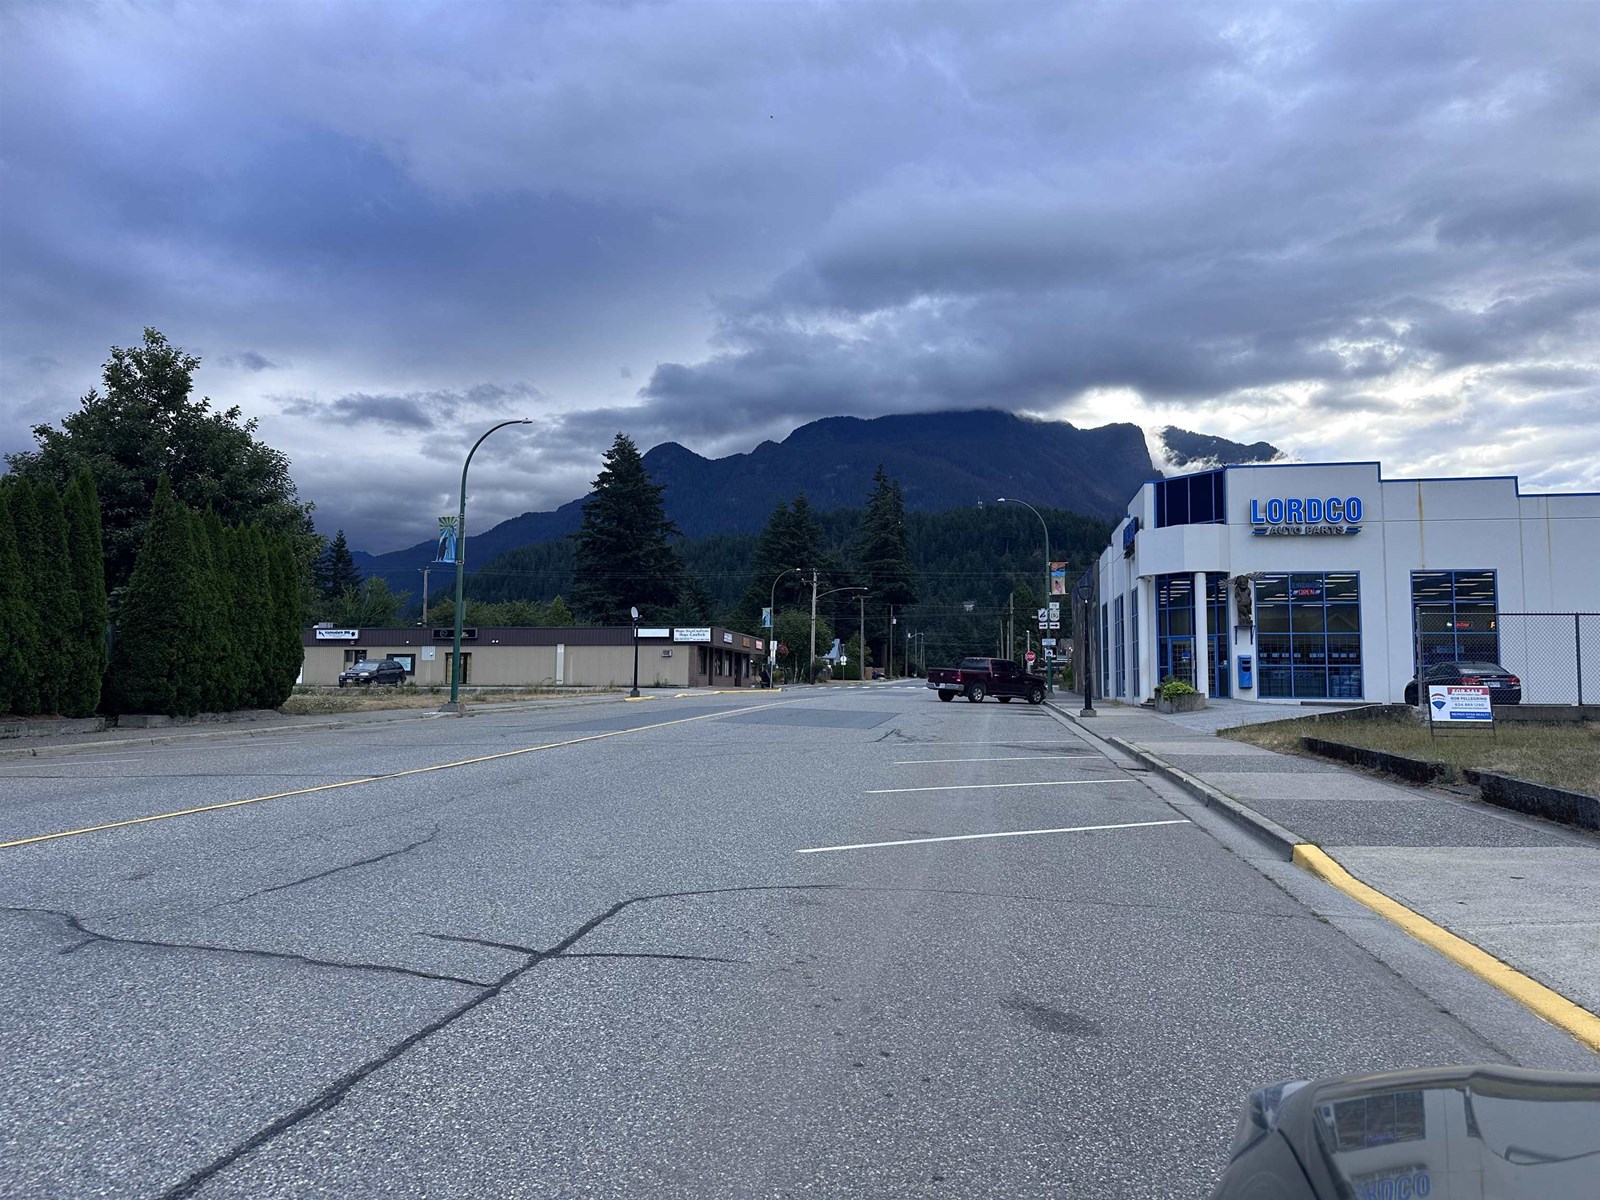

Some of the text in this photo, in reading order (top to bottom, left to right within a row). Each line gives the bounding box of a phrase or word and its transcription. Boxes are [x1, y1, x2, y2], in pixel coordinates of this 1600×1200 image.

[1250, 497, 1363, 524] LORDCO
[1270, 525, 1344, 535] AUTO PARTS
